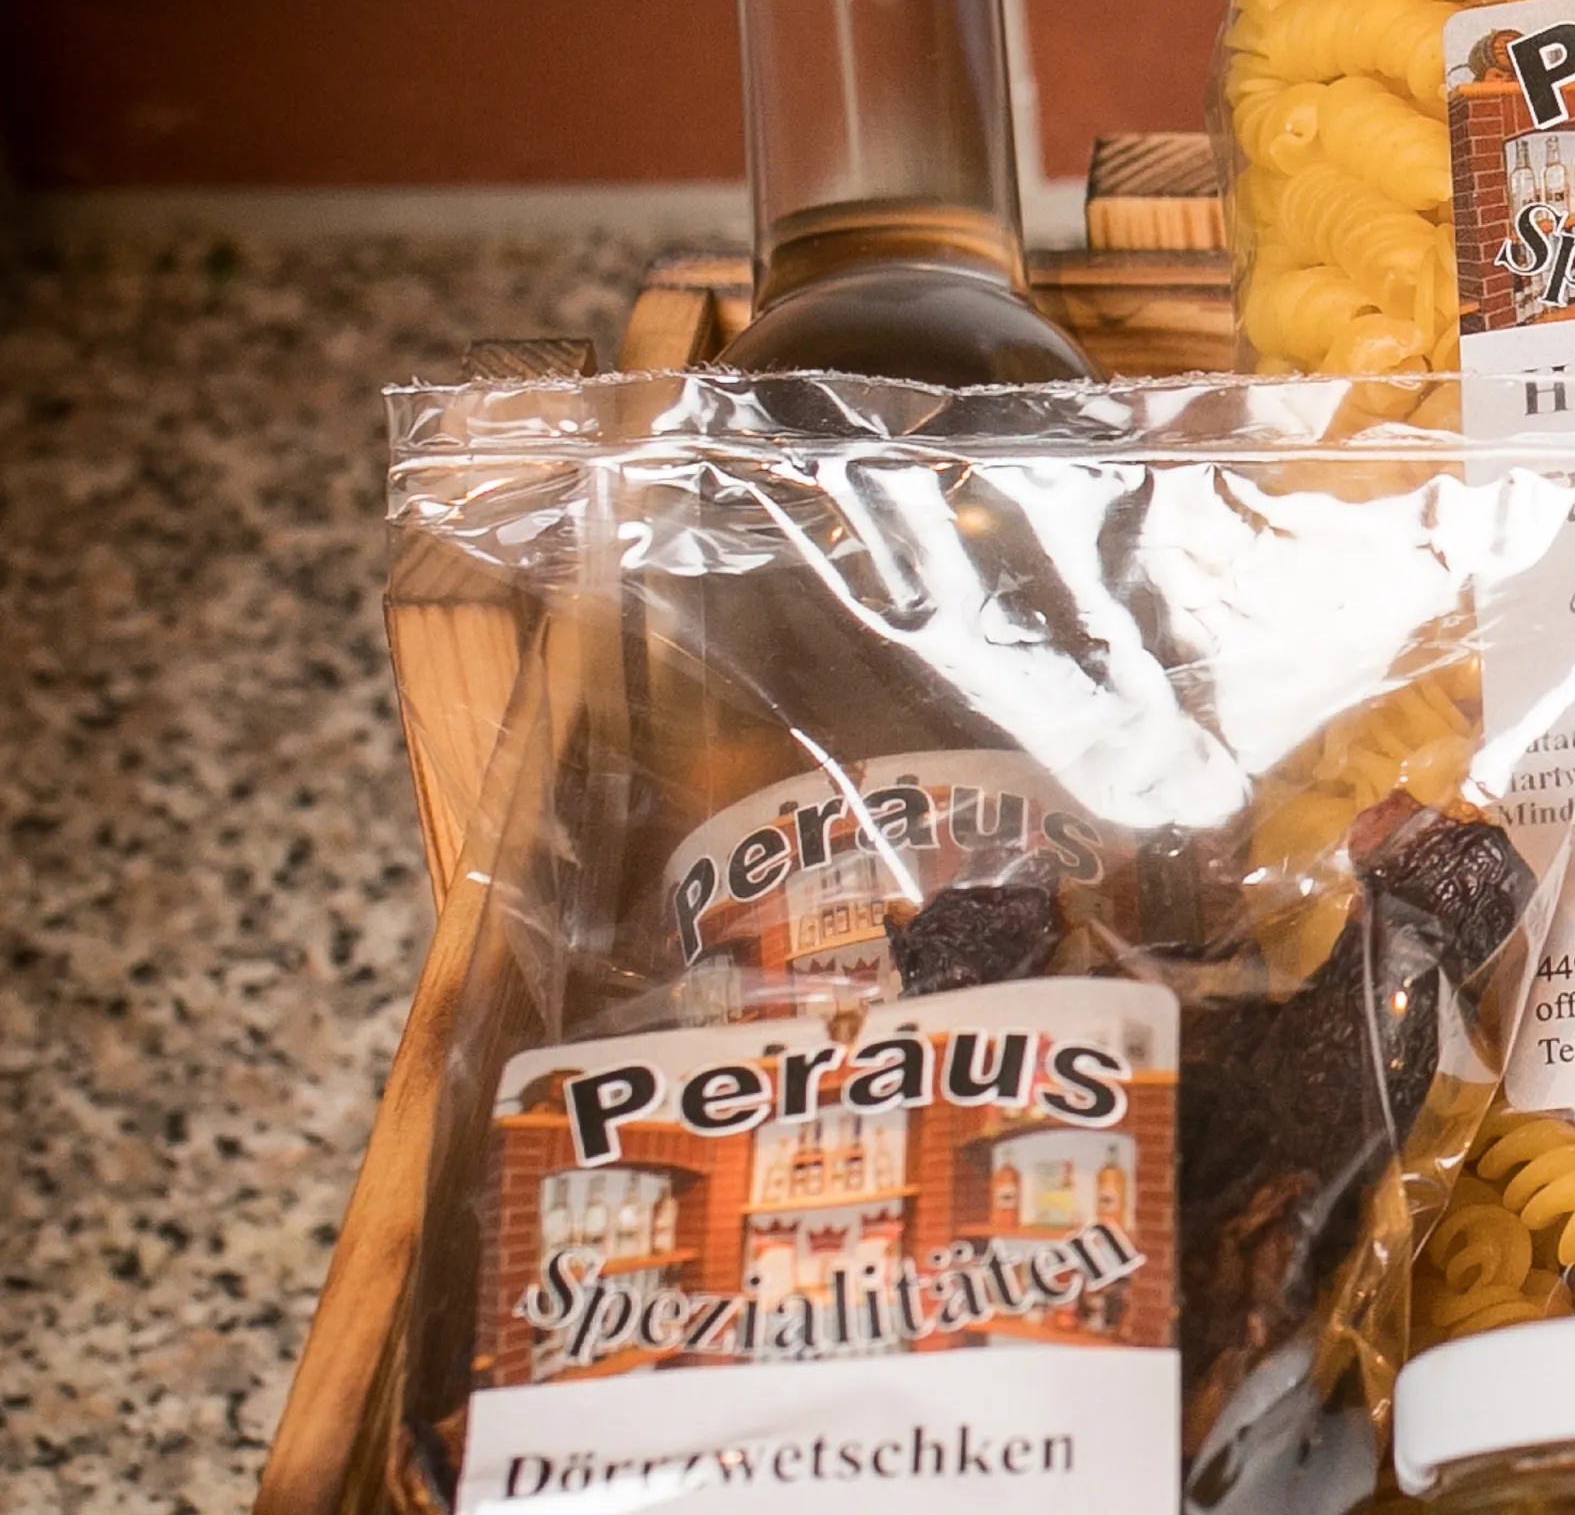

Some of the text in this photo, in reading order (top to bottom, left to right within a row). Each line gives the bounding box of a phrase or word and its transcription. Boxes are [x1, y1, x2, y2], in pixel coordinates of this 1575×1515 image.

[674, 784, 1104, 966] Peraus
[565, 1029, 1132, 1167] Peraus
[518, 1220, 1146, 1362] Spezialitäten
